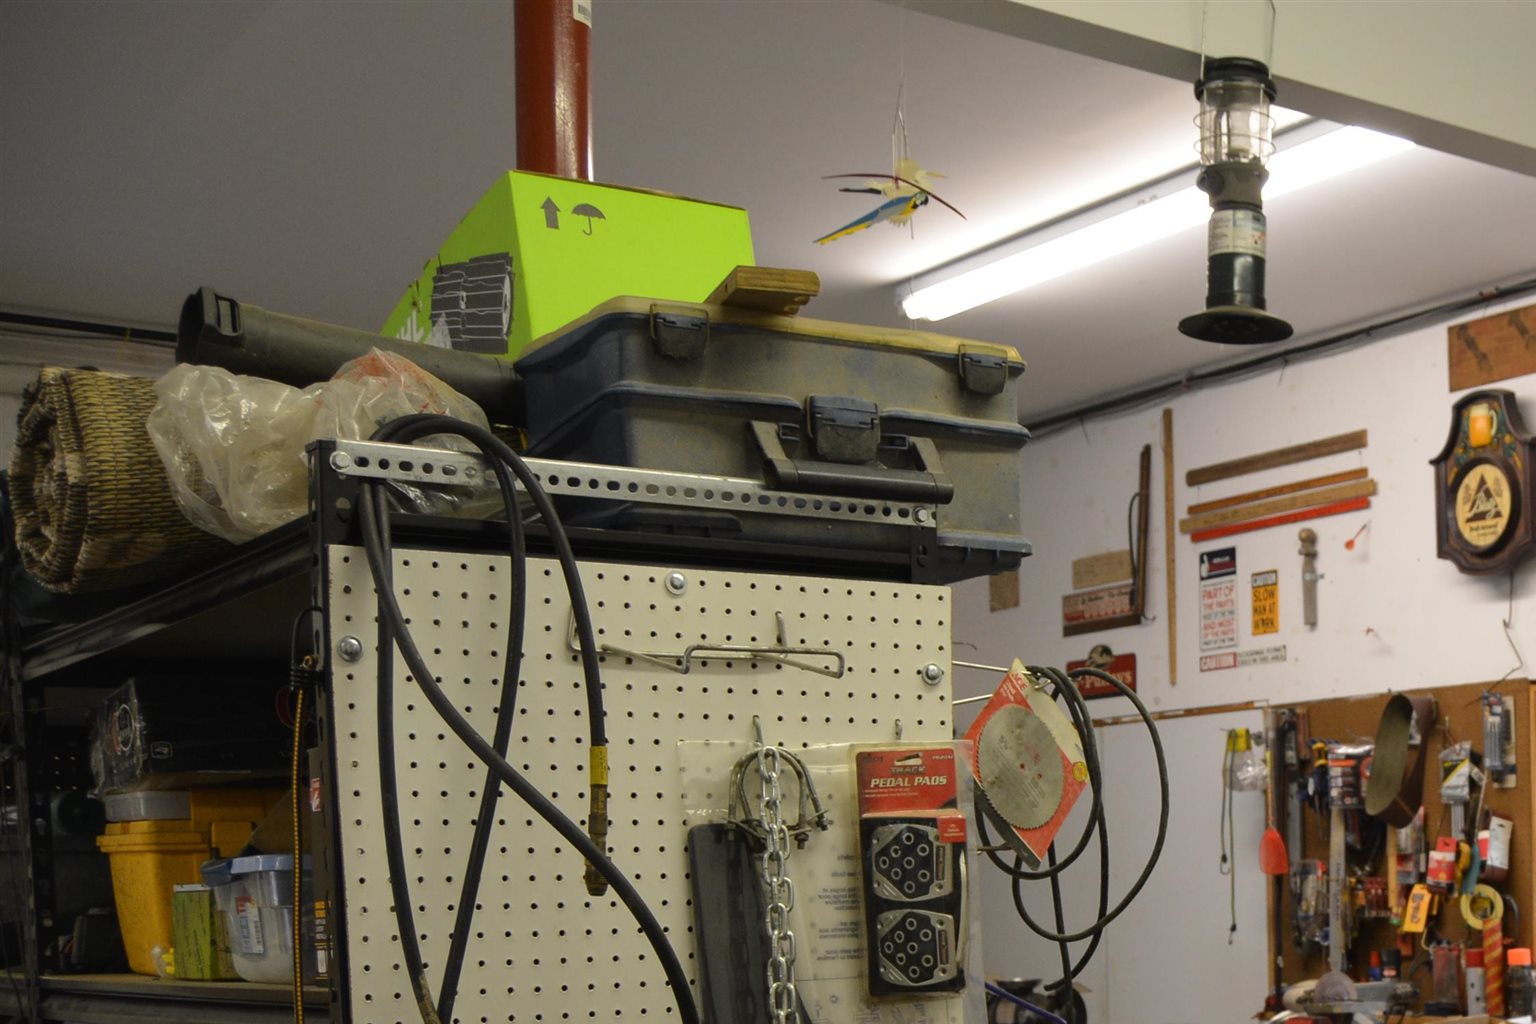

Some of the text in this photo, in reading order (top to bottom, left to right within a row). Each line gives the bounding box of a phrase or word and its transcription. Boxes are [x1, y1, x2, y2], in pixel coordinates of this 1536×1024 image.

[1253, 588, 1276, 603] SLOW
[870, 775, 948, 788] PEDAL PADS
